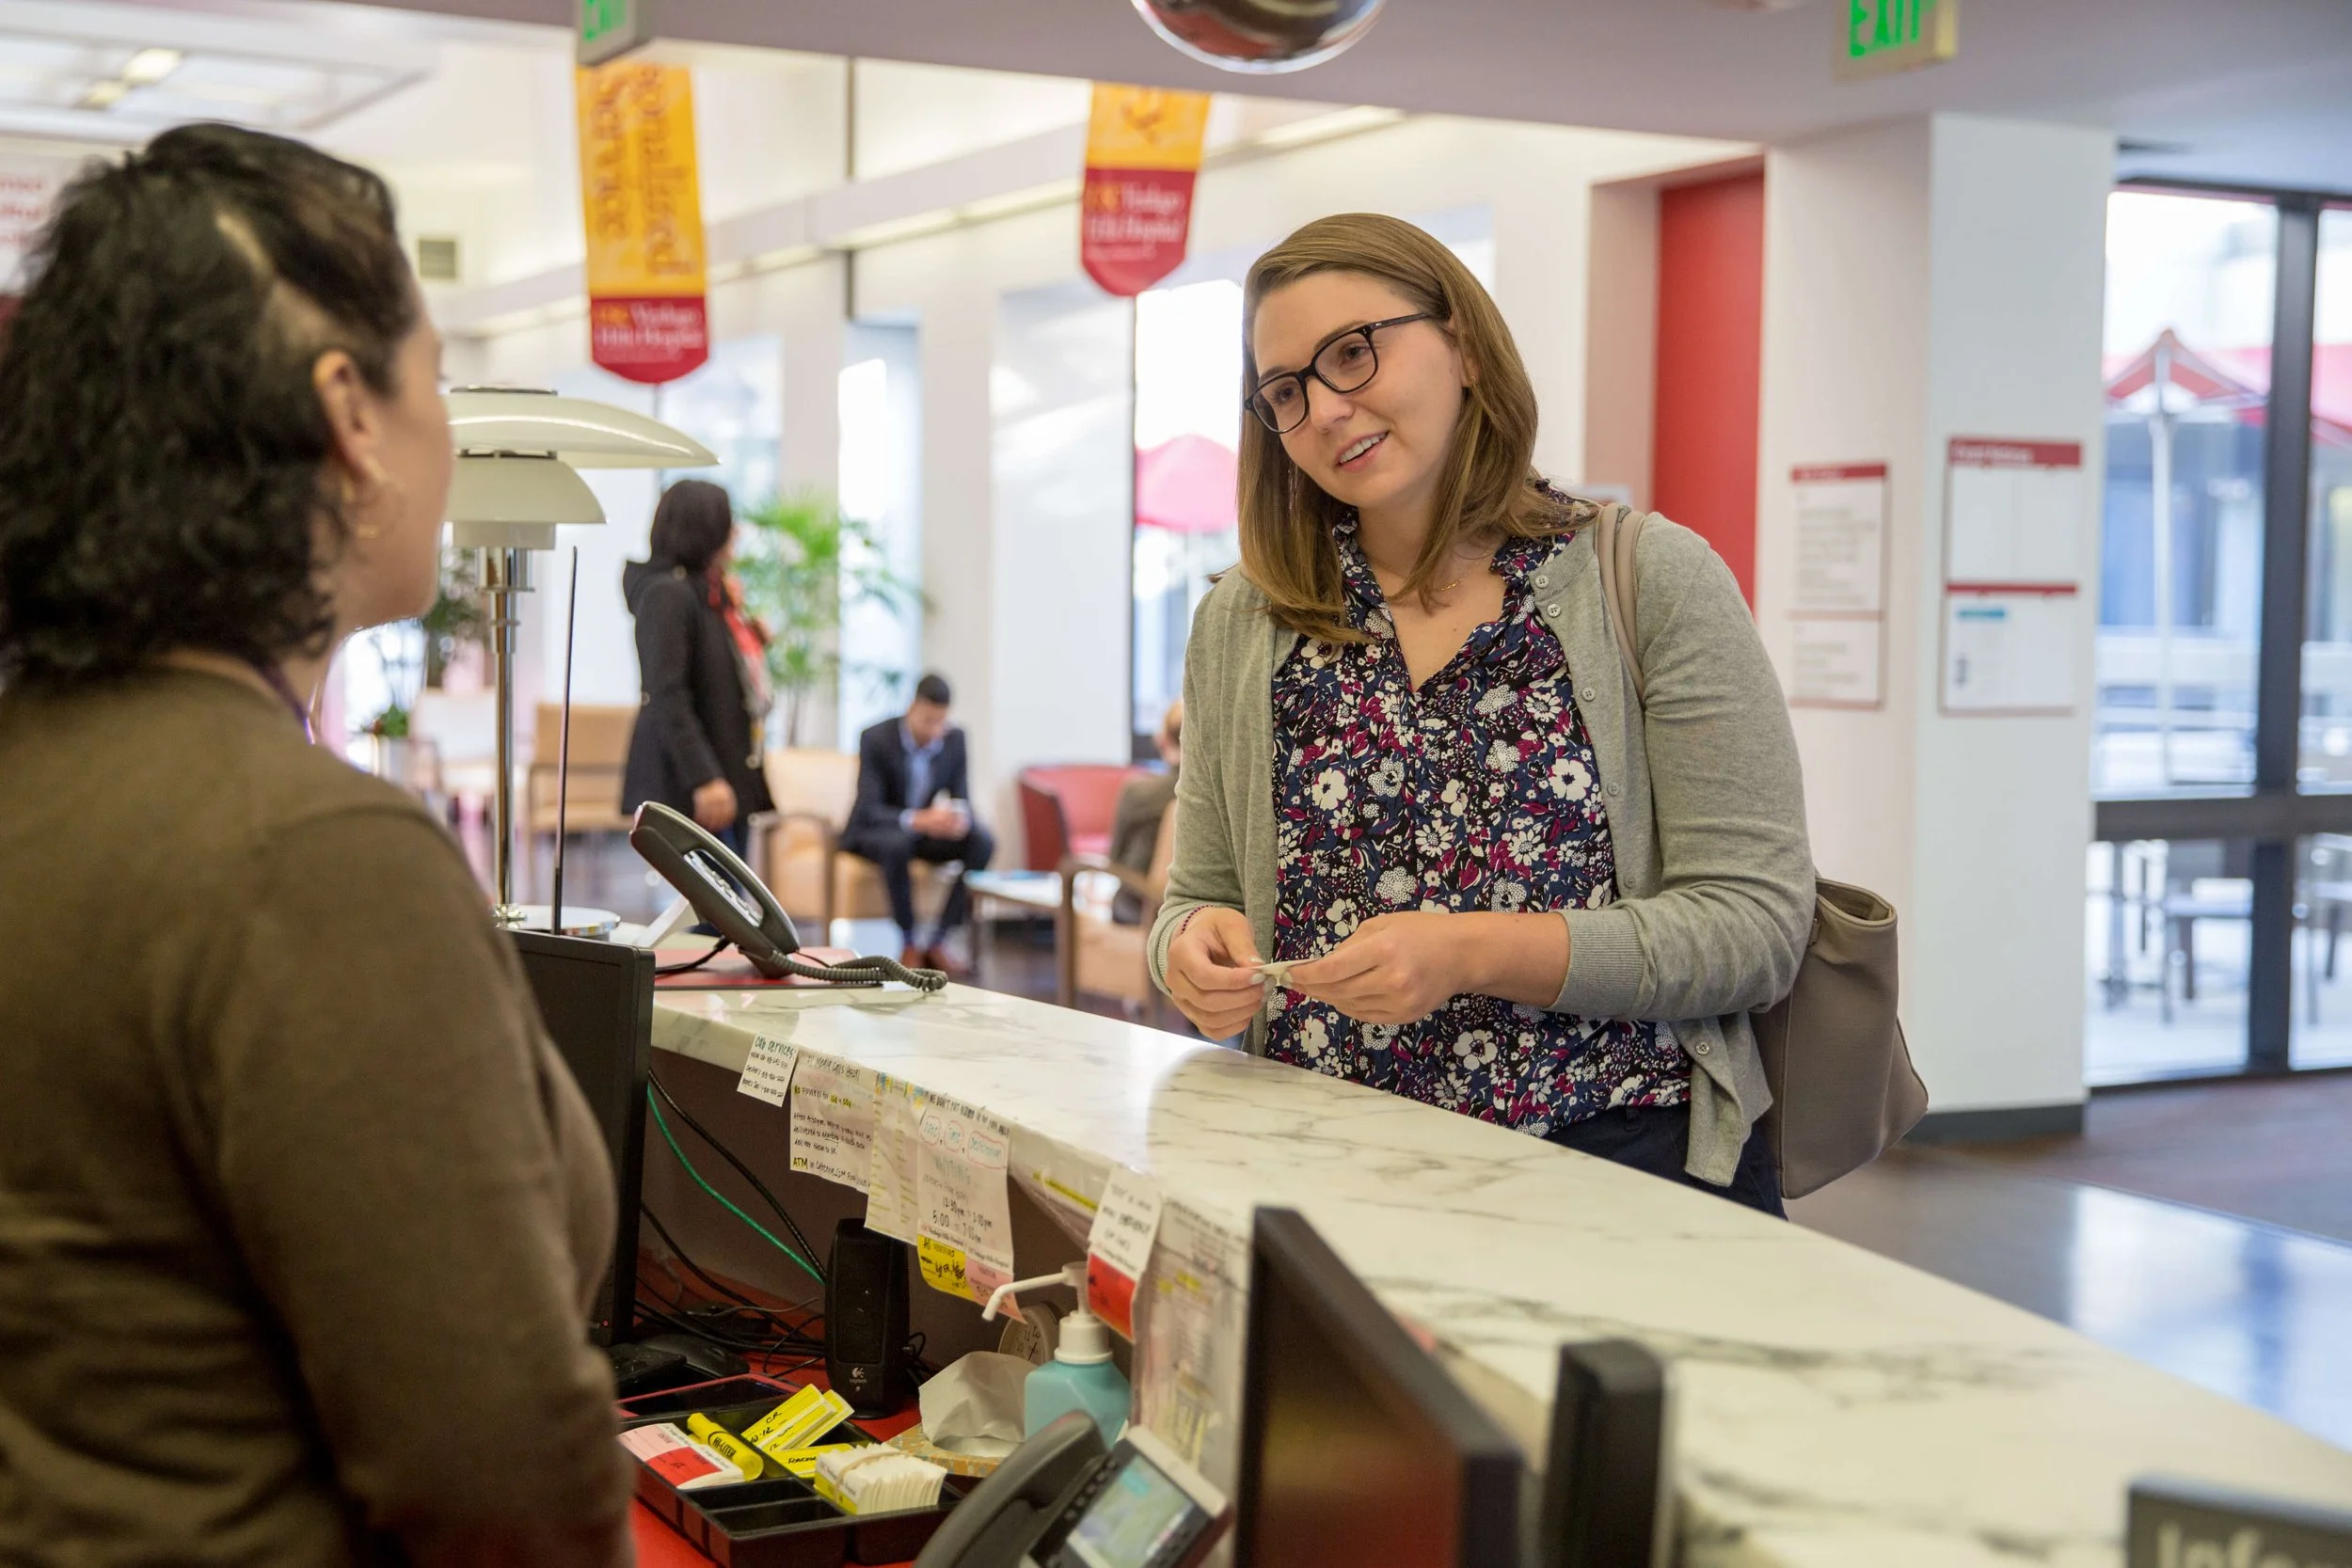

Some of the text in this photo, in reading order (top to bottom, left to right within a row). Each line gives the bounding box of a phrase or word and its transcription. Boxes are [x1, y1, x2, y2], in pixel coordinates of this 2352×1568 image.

[793, 1157, 808, 1171] ATM
[932, 1210, 950, 1227] 5:00
[712, 1436, 737, 1461] HI-LITER
